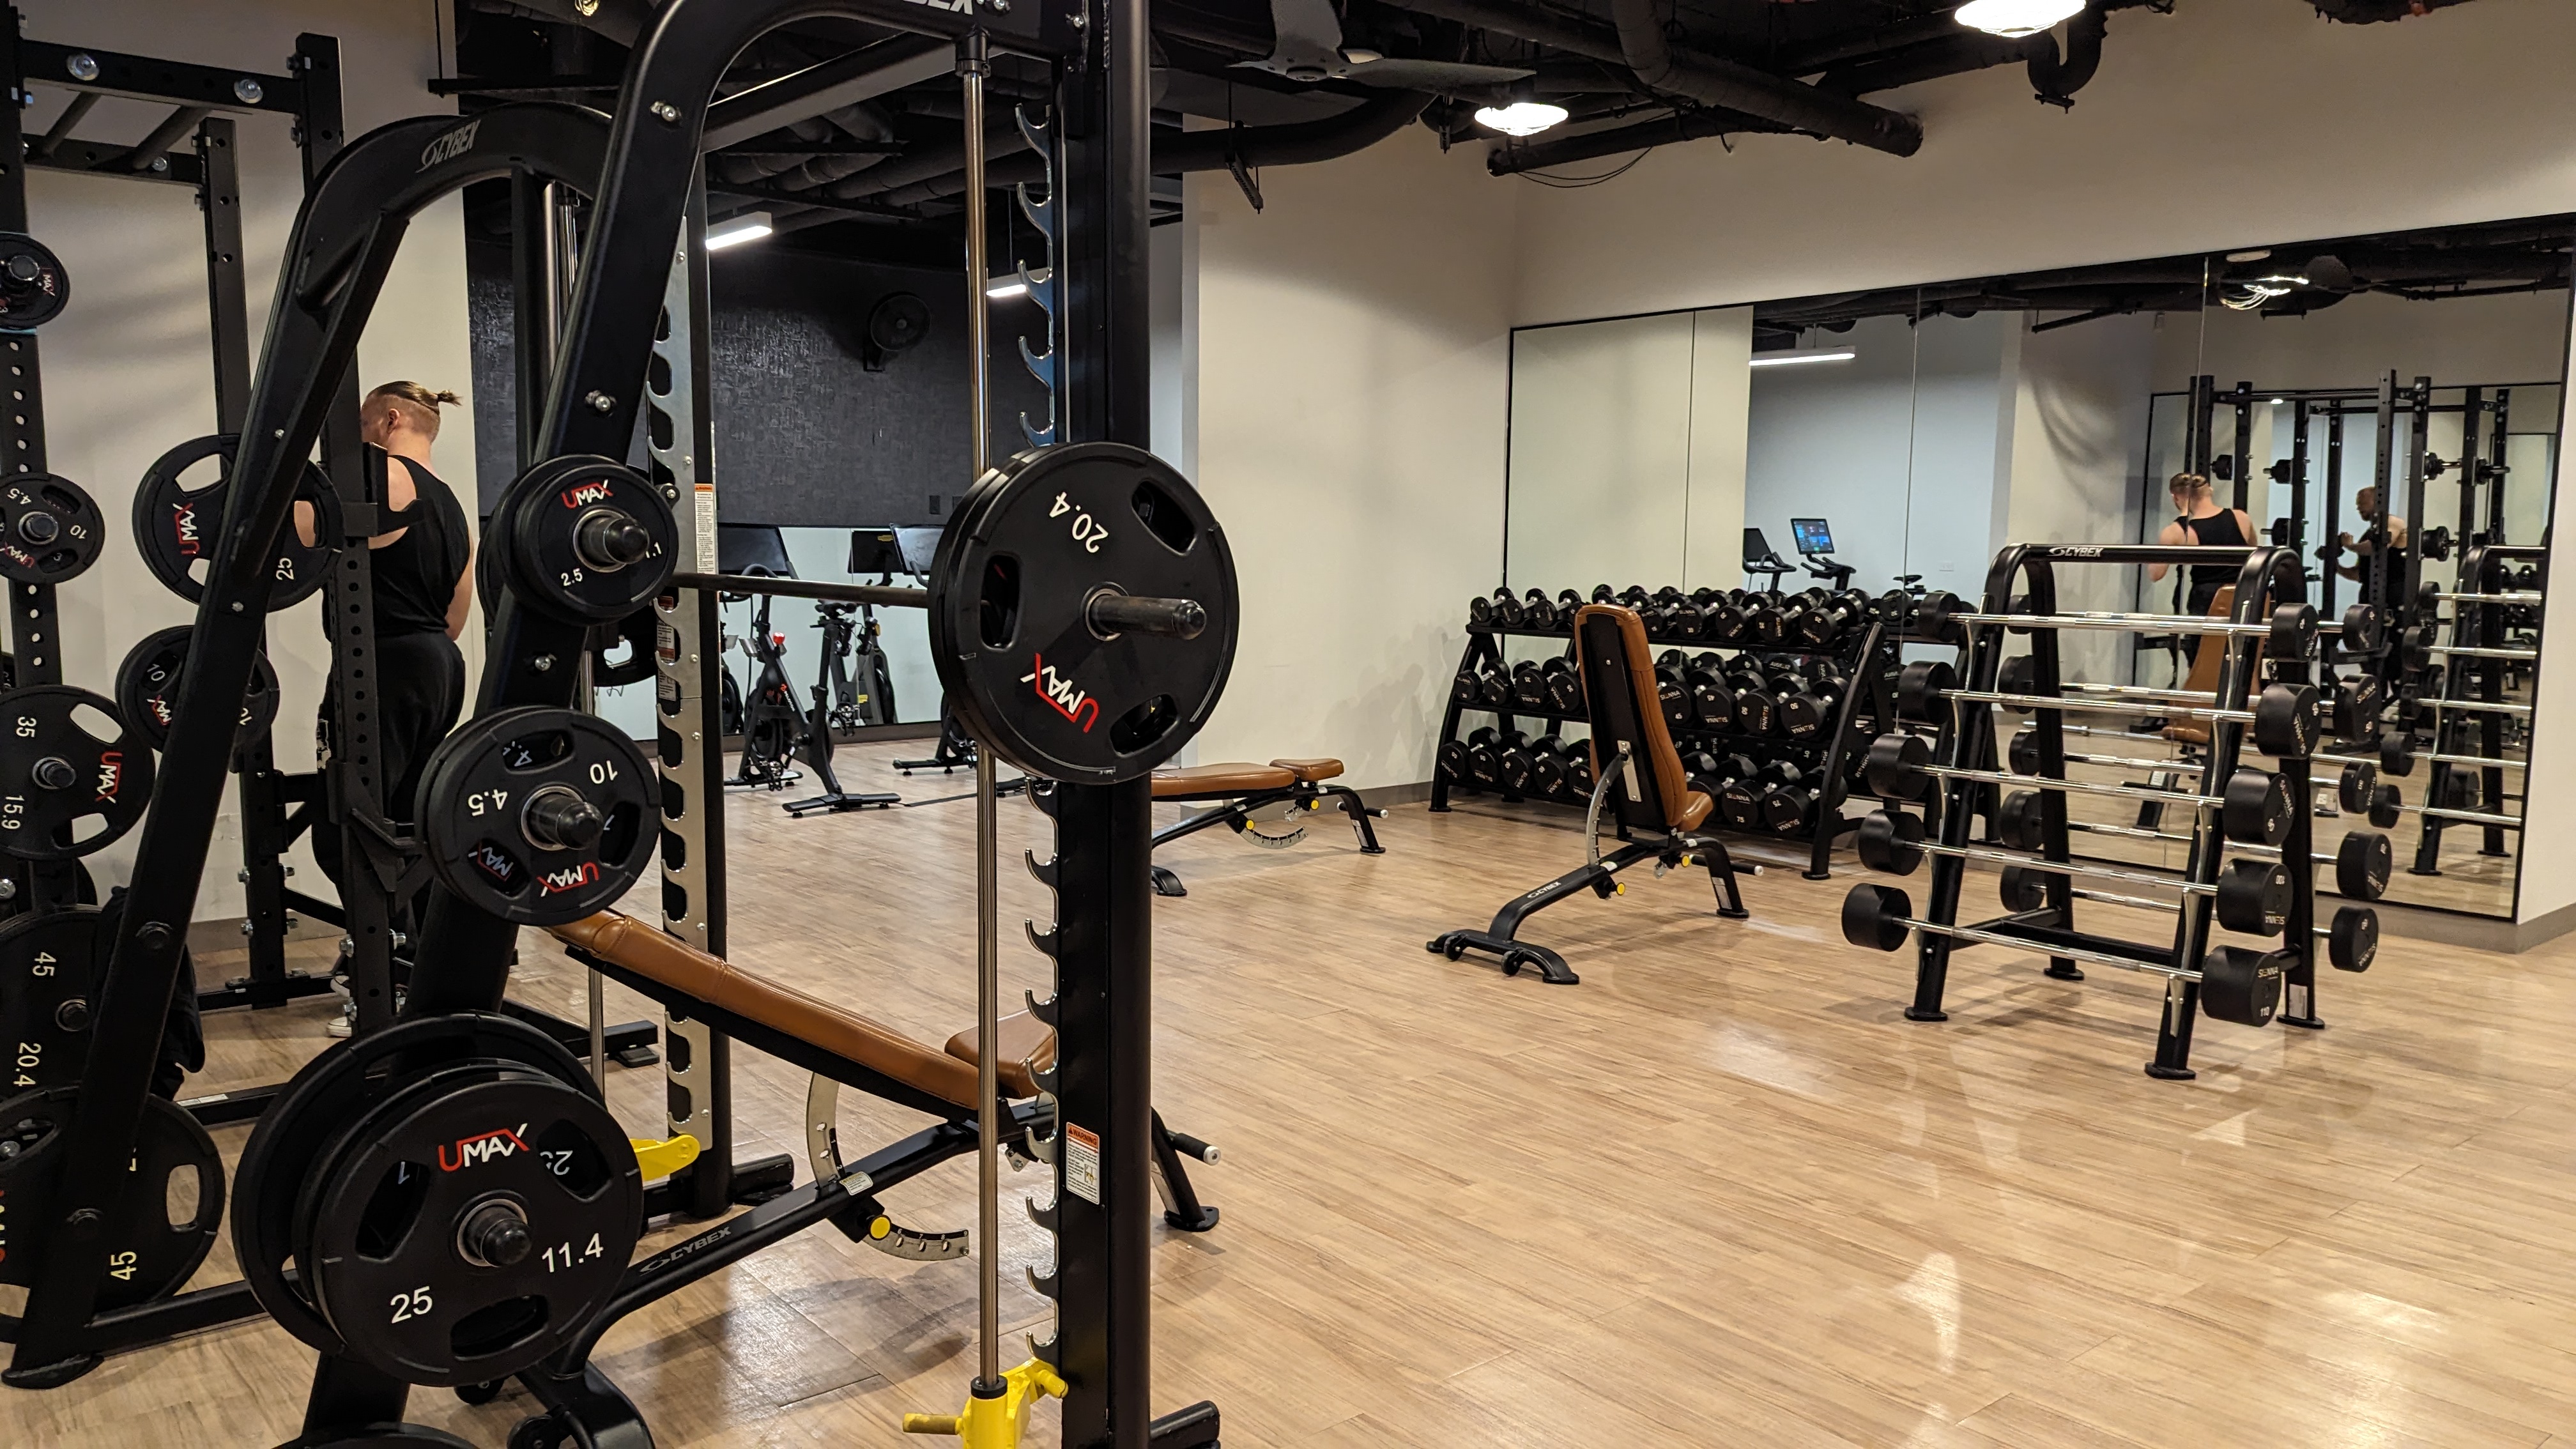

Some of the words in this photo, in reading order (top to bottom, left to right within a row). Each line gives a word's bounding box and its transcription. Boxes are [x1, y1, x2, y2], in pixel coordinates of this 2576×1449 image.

[434, 119, 480, 165] CYBEX
[7, 488, 32, 505] 4.5
[561, 479, 613, 509] UMAX
[70, 525, 88, 540] 10
[172, 503, 200, 555] UMAX
[1049, 491, 1109, 553] 20.4
[2064, 546, 2104, 557] CYBEX
[275, 558, 295, 581] 25
[560, 567, 583, 586] 2.5
[147, 663, 165, 682] 10
[1020, 652, 1099, 733] UMAX
[1660, 690, 1682, 701] SIENNA
[146, 694, 172, 726] MAX
[16, 716, 37, 738] 35
[1791, 724, 1815, 734] SIENNA
[95, 751, 123, 804] UMAX
[590, 760, 619, 785] 10
[468, 788, 508, 816] 4.5
[1726, 792, 1750, 802] SIENNA
[1, 795, 25, 830] 15.9
[1777, 818, 1800, 831] SIENNA
[468, 842, 514, 882] MAX
[537, 861, 599, 898] UMAX
[33, 951, 57, 977] 45
[2257, 966, 2279, 978] SIENNA
[2260, 1006, 2270, 1017] 110
[13, 1042, 42, 1087] 20.4
[438, 1123, 530, 1172] UMAX
[1073, 1128, 1098, 1146] WARNING
[542, 1232, 604, 1273] 11.4
[671, 1227, 732, 1261] CYBEX
[110, 1251, 137, 1280] 45
[390, 1285, 433, 1324] 25
